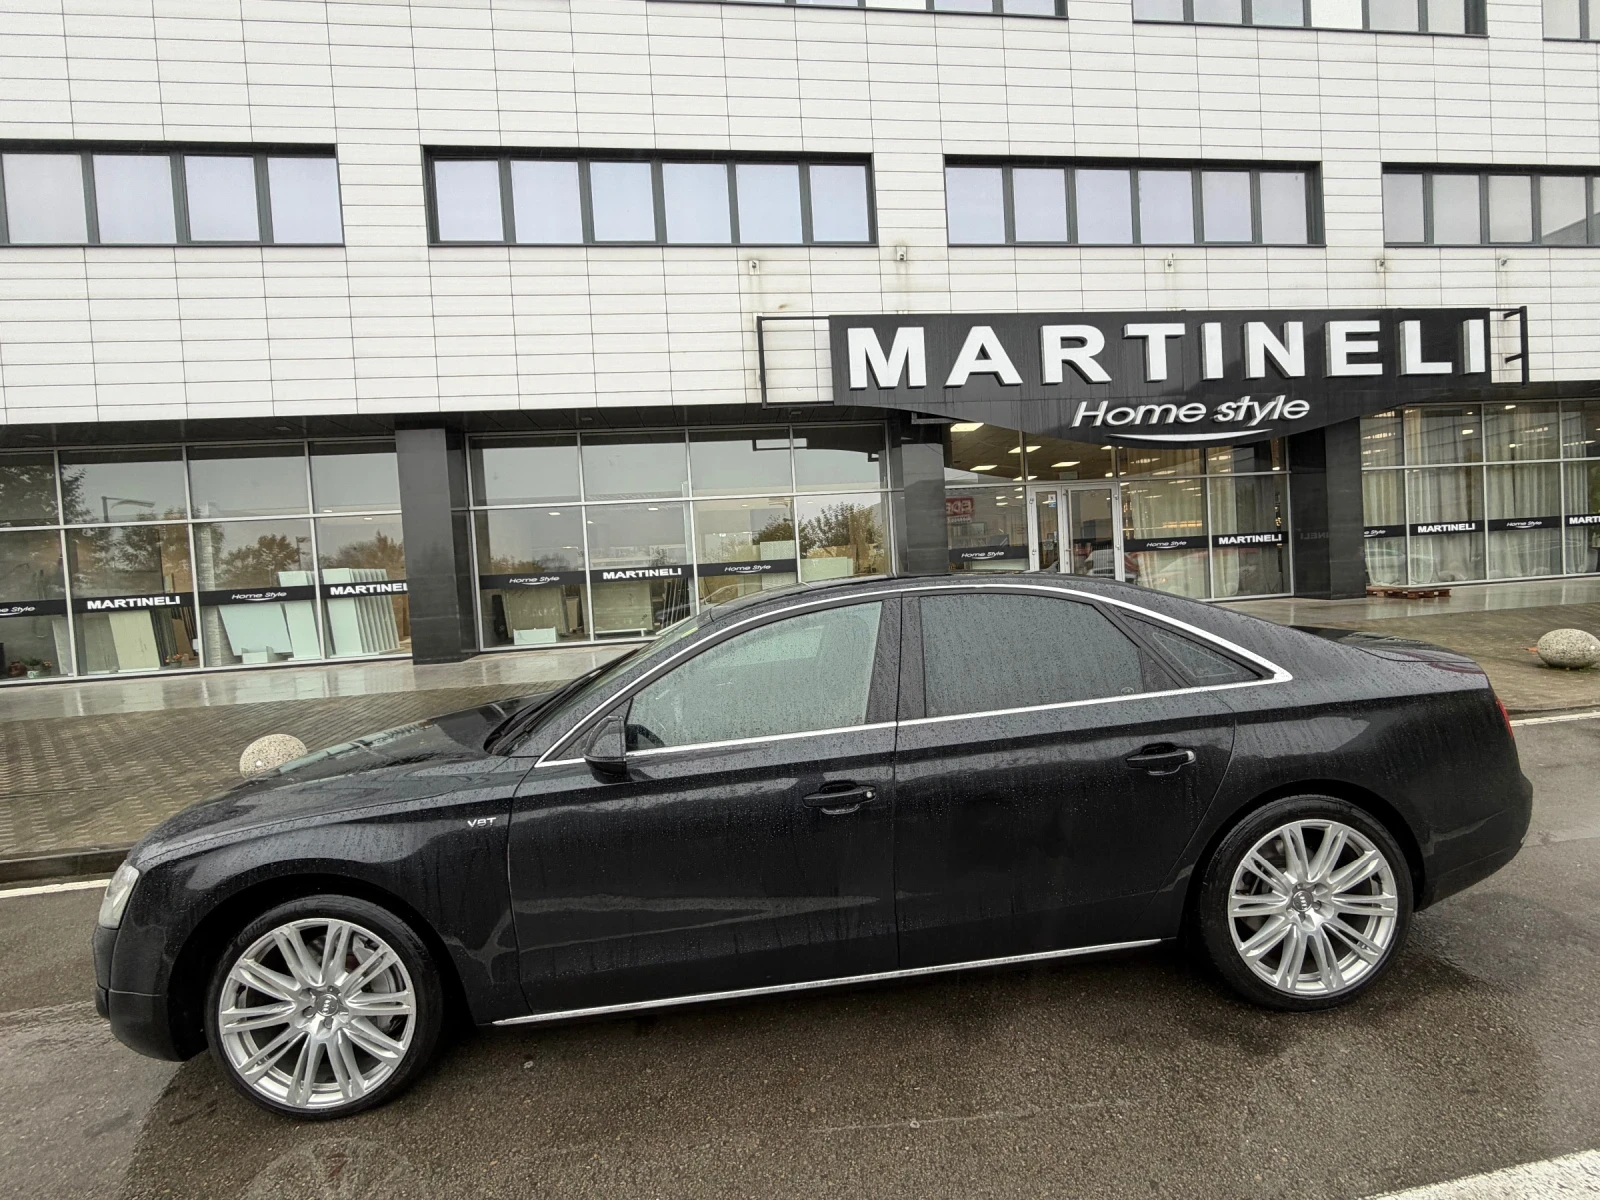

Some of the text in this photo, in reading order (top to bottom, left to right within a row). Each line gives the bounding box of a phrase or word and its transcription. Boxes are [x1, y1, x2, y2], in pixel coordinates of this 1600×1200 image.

[847, 318, 1487, 390] MARTINELI
[1070, 394, 1311, 429] Home style
[1417, 522, 1476, 534] MARTINELI
[1170, 540, 1188, 548] Style
[1218, 533, 1282, 545] MARTINELI
[987, 550, 1005, 558] Style
[539, 575, 560, 583] Style
[602, 567, 682, 580] MARTINELI
[264, 591, 288, 599] Style
[86, 595, 181, 610] MARTINELI
[11, 605, 36, 614] Style
[467, 816, 497, 828] V8T
